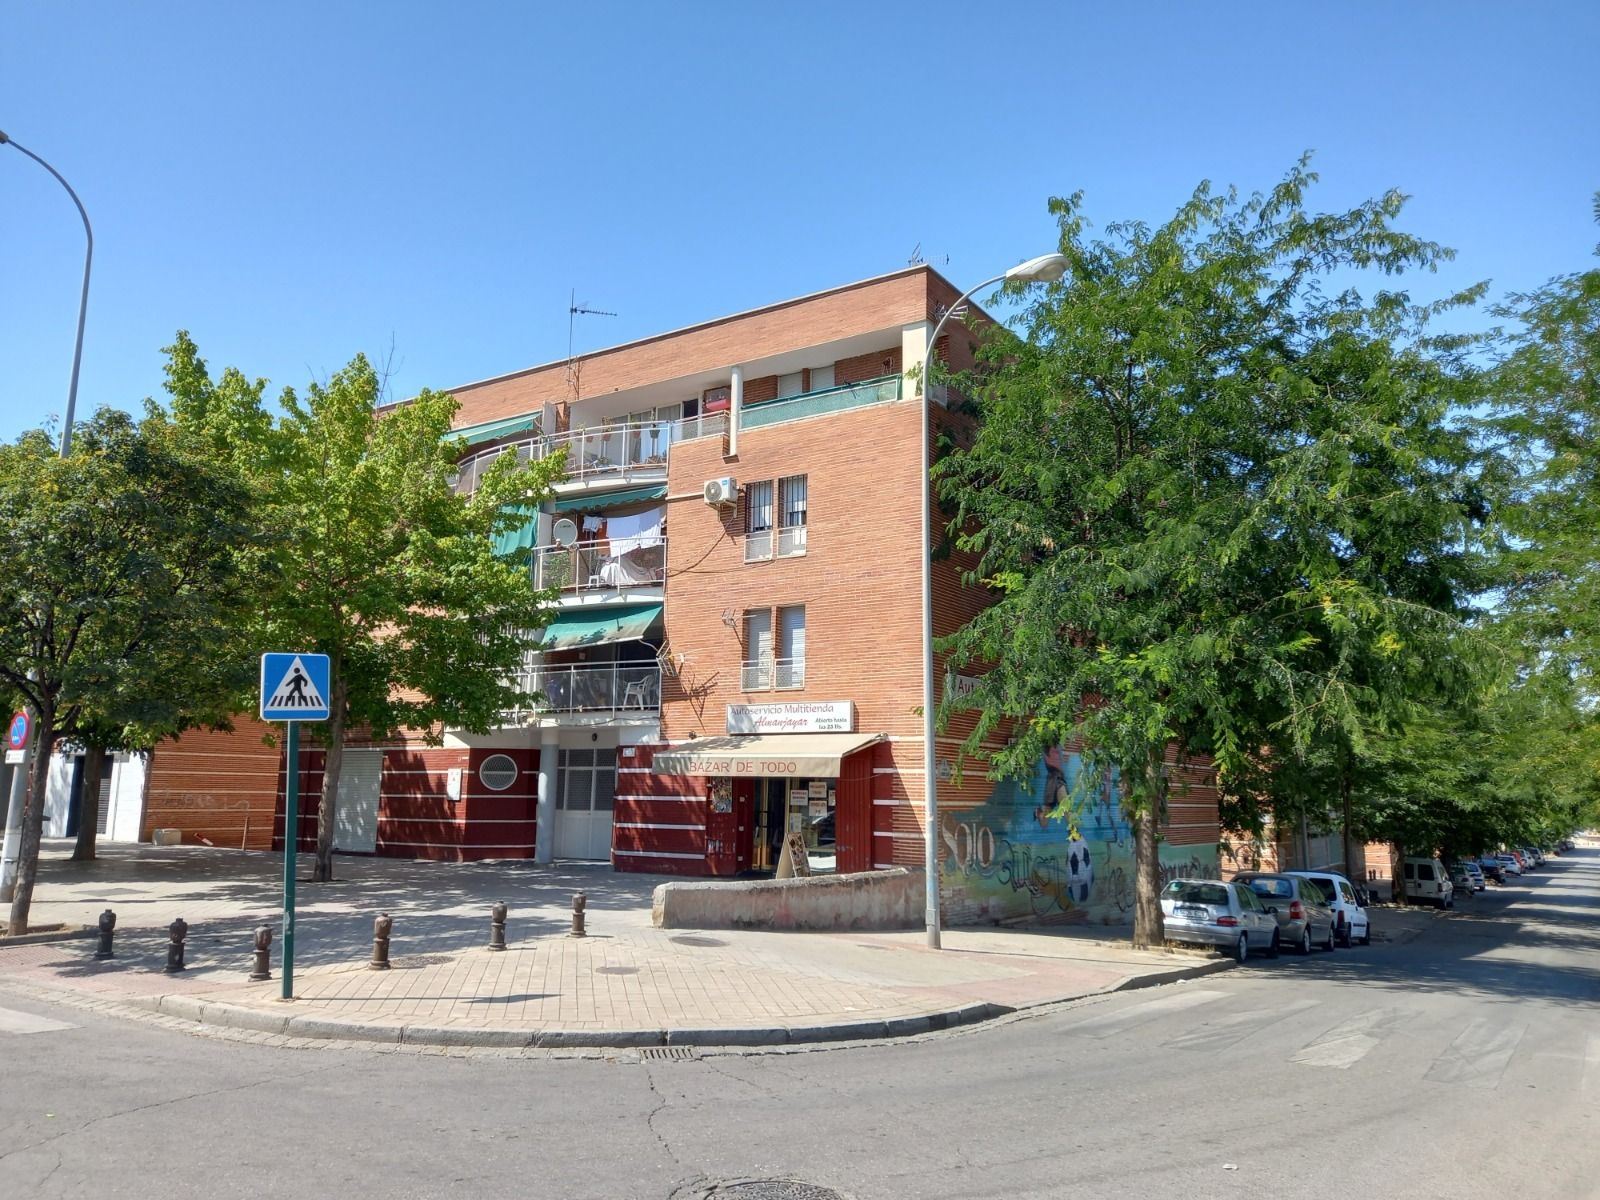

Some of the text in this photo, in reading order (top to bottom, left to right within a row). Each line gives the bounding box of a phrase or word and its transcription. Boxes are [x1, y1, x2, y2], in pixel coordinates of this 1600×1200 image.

[731, 703, 834, 716] Autoservicio Multitienda
[755, 715, 808, 731] Almanjayar
[689, 761, 797, 773] BAZAR DE TODO
